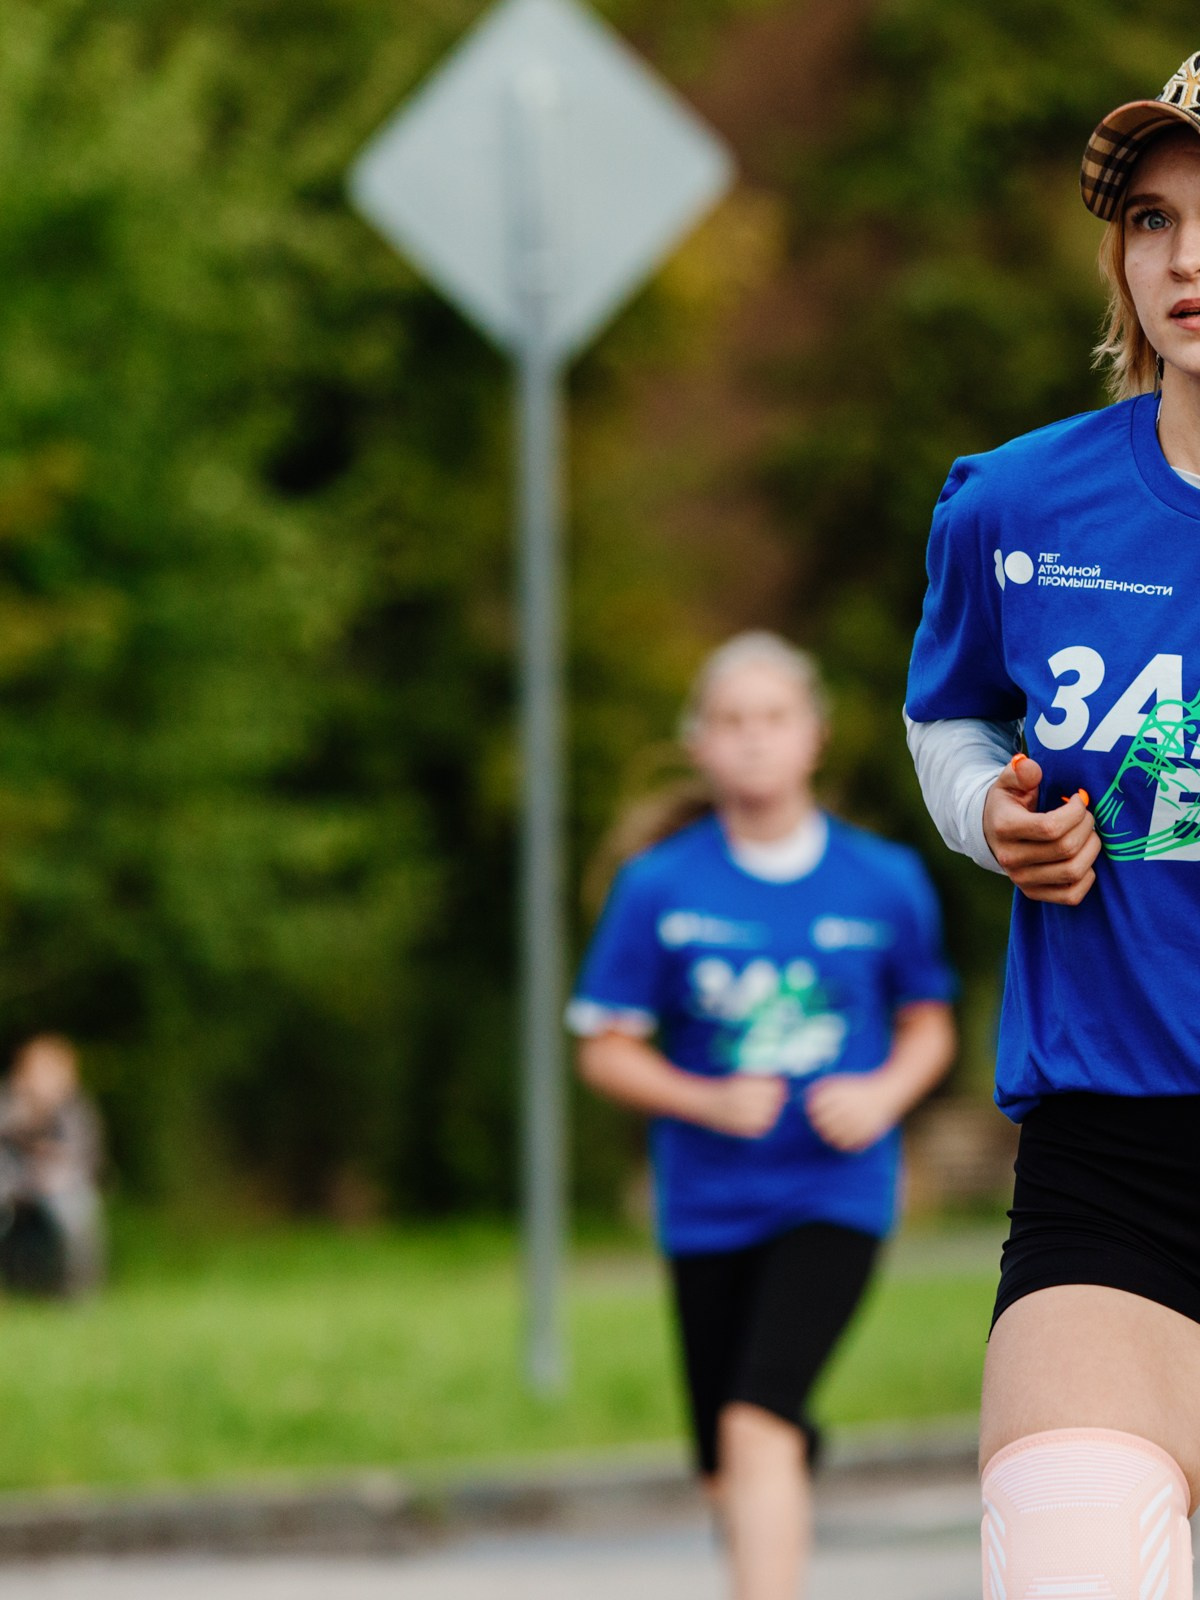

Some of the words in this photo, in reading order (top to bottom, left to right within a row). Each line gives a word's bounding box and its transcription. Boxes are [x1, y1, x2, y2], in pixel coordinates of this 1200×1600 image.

[1038, 552, 1061, 563] ЛЕТ
[1038, 564, 1101, 578] АТОМНОЙ
[1038, 575, 1173, 597] ПРОМЫШЛЕННОСТИ
